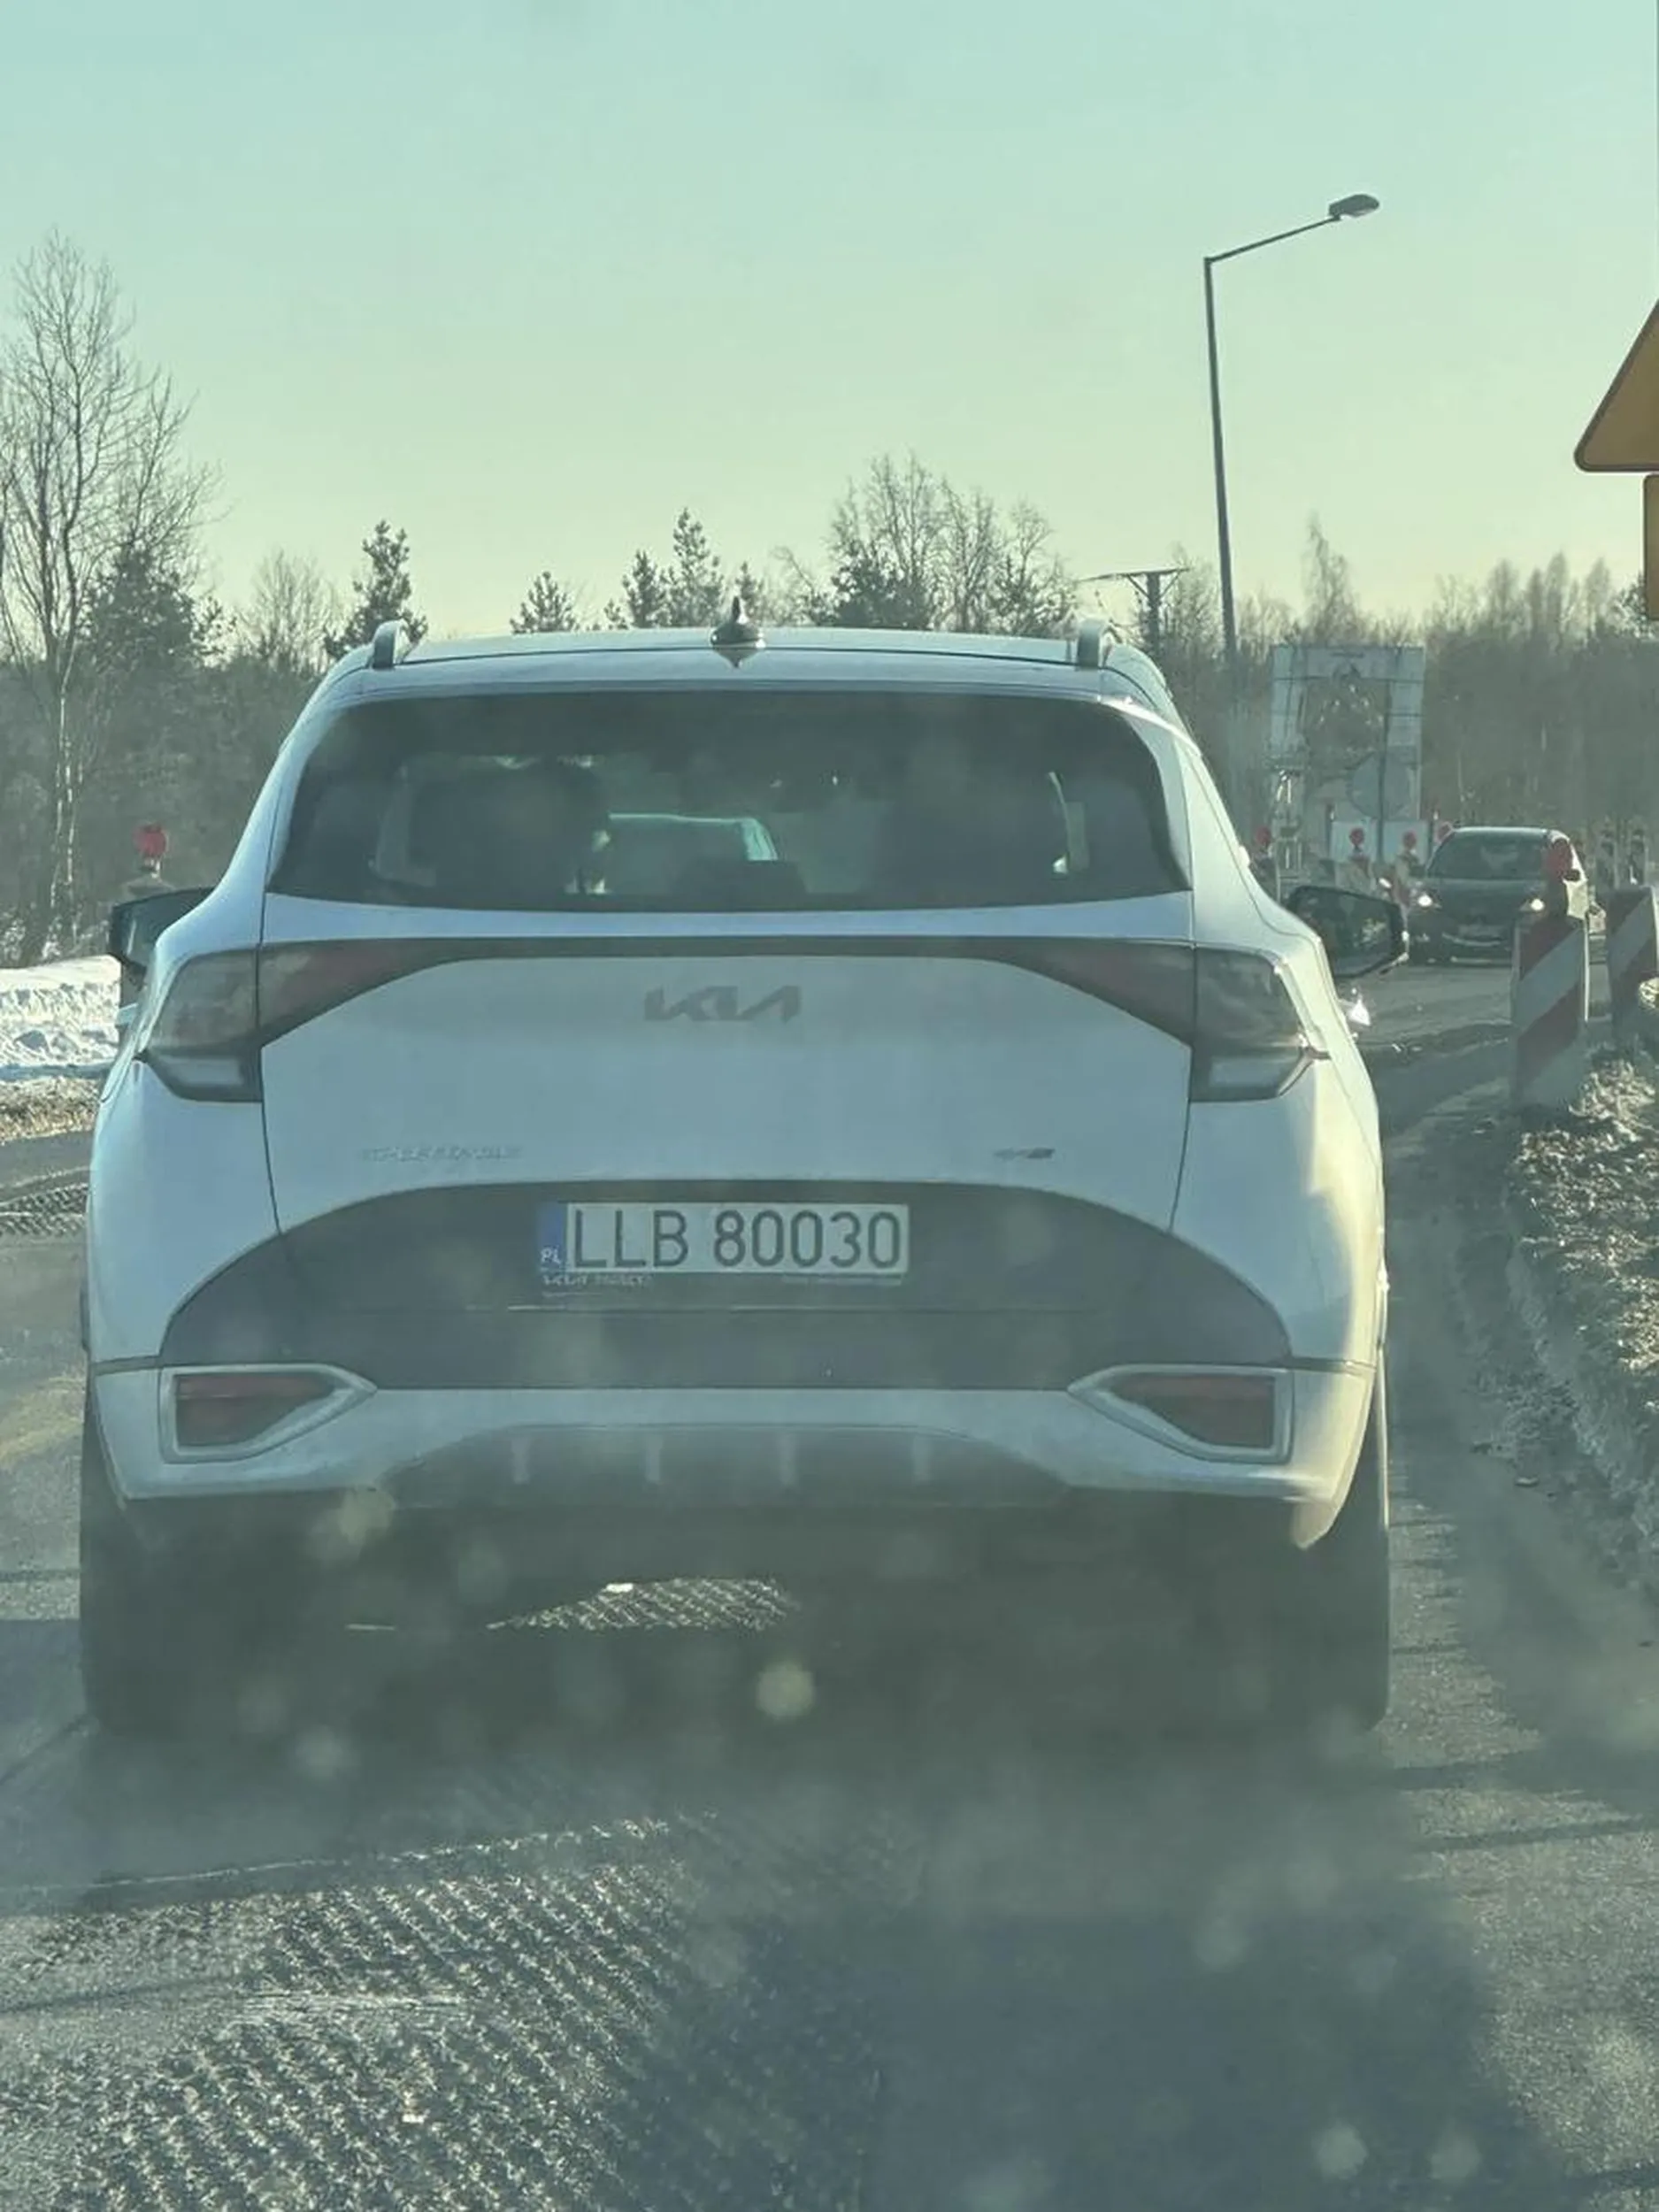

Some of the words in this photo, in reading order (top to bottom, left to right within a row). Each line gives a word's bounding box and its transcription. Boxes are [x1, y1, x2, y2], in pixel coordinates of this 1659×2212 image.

[541, 1247, 561, 1263] PL
[574, 1210, 688, 1268] LLB
[713, 1210, 901, 1268] 80030
